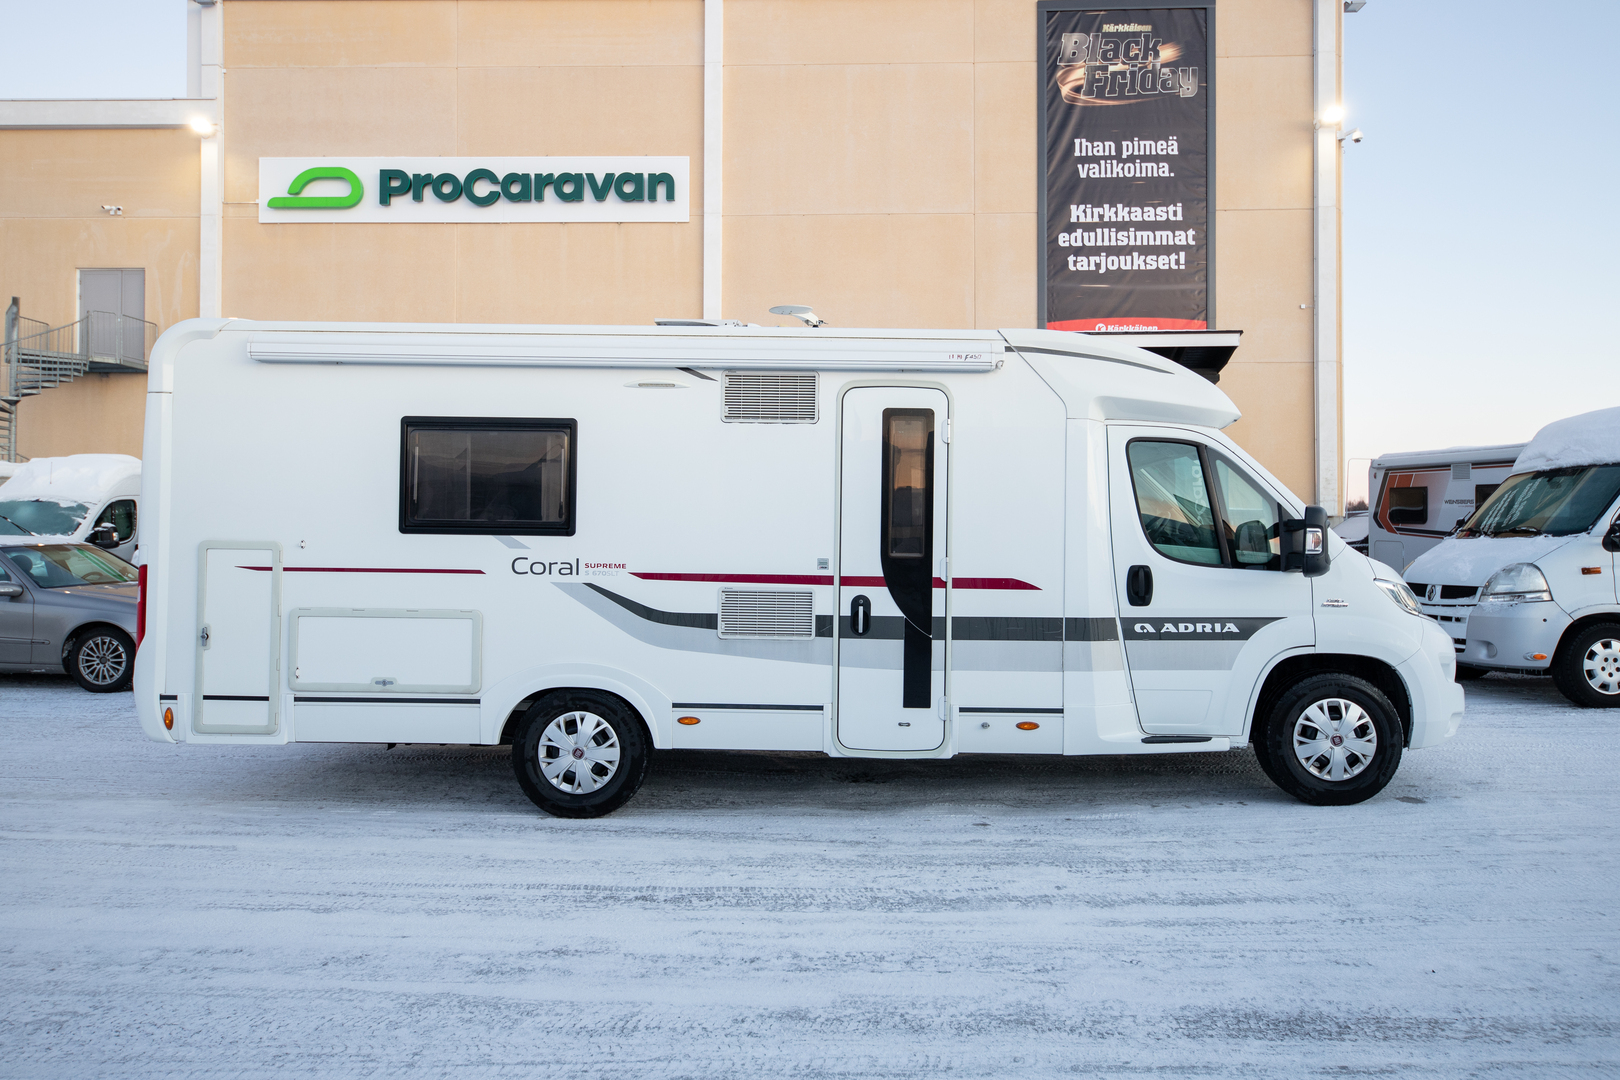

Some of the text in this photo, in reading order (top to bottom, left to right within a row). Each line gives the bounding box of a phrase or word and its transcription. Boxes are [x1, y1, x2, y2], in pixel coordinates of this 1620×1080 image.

[1057, 33, 1162, 65] Black
[1081, 63, 1198, 98] Friday
[1074, 136, 1179, 158] Ihan pimeä
[1077, 159, 1175, 178] valikoima.
[379, 168, 676, 207] ProCaravan
[1070, 203, 1183, 222] Kirkkaasti
[1058, 228, 1196, 246] edullisimmat
[1067, 251, 1186, 273] tarjoukset!
[511, 556, 580, 576] Coral
[1160, 623, 1240, 633] ADRIA
